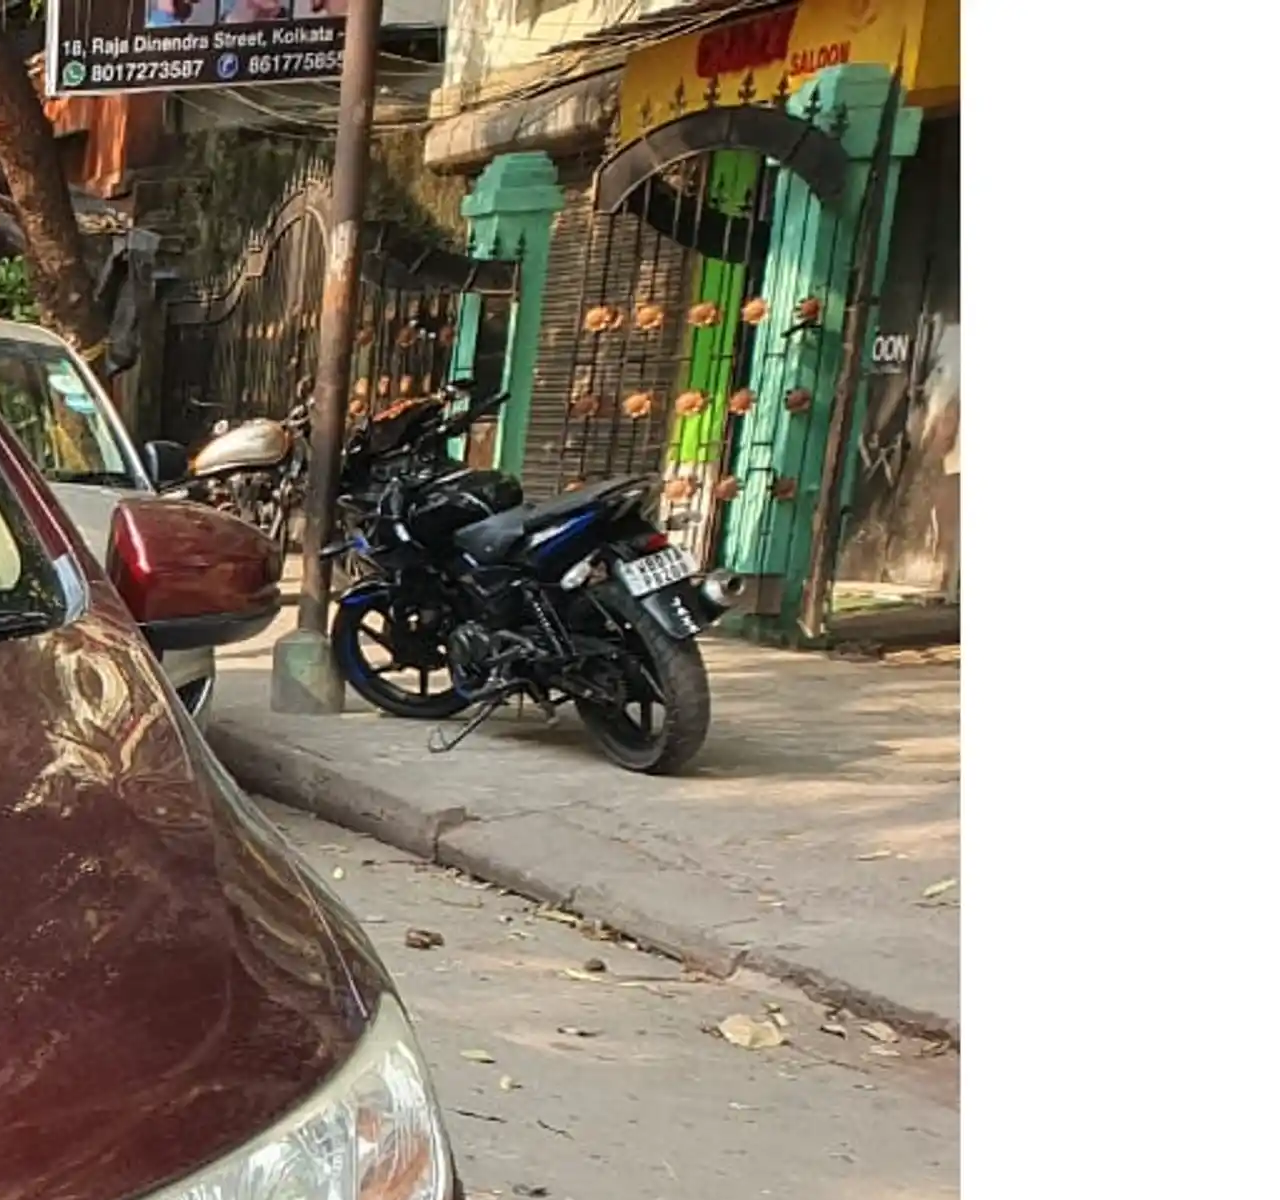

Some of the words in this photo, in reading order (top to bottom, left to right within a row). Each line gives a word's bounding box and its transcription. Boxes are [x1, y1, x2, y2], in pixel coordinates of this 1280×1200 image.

[92, 37, 129, 59] Raja
[134, 33, 209, 52] Dinendra
[213, 29, 267, 50] Street,
[272, 25, 334, 44] Kolkata
[790, 40, 851, 76] SALOON
